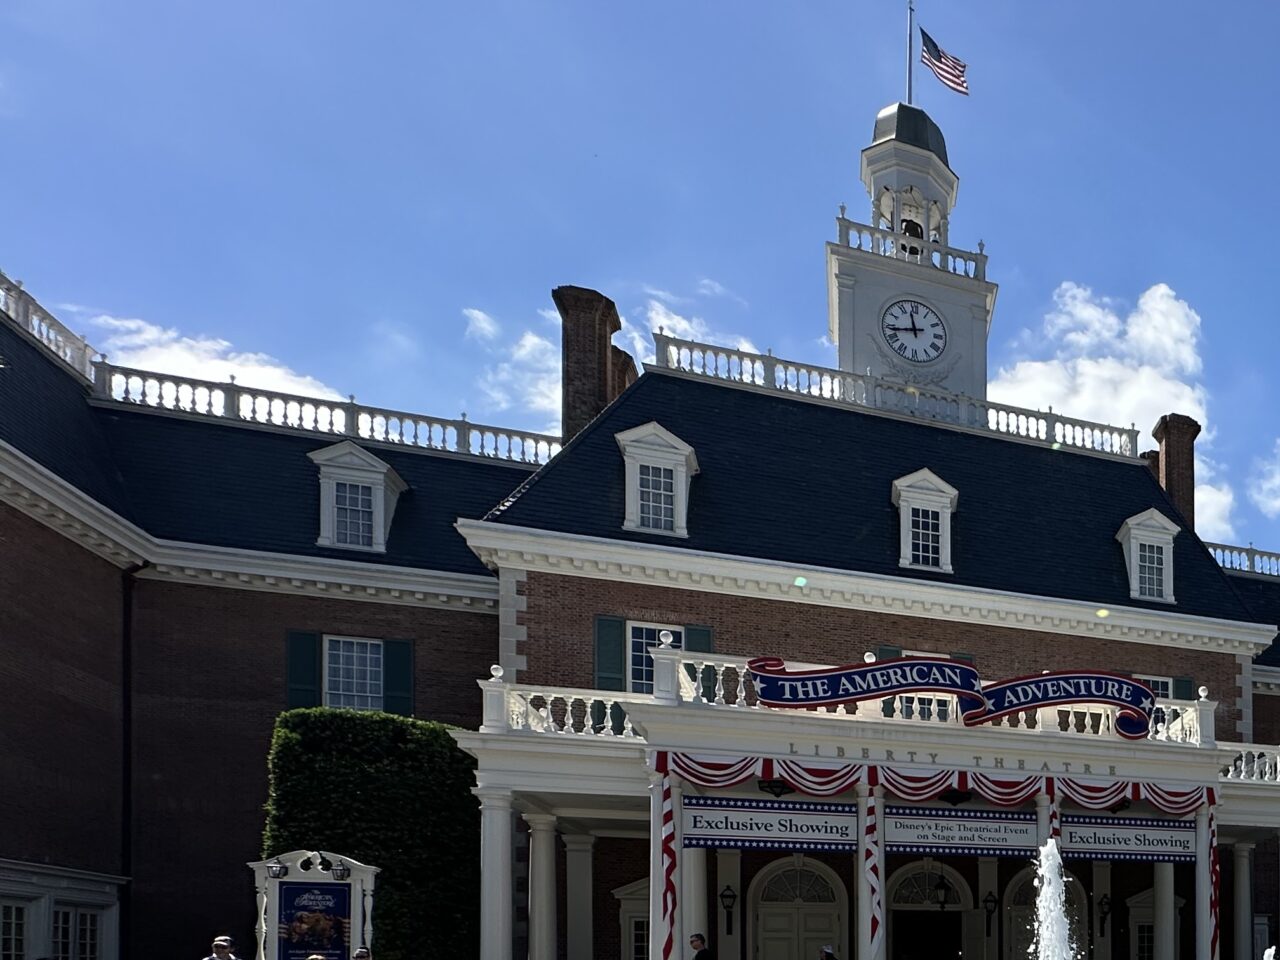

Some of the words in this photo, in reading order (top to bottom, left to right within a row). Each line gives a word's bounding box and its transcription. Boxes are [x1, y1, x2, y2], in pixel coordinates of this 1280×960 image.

[778, 679, 832, 699] THE
[838, 665, 962, 695] AMERICAN
[1003, 678, 1133, 707] ADVENTURE
[789, 742, 939, 764] LIBERTY
[973, 756, 1116, 776] THEATRE
[692, 815, 774, 832] Exclusive
[777, 818, 849, 838] Showing
[894, 820, 932, 832] Disney's
[934, 823, 954, 833] Epic
[956, 823, 1001, 834] Theatrical
[1003, 825, 1029, 835] Event
[931, 832, 956, 843] Stage
[958, 833, 975, 842] and
[978, 834, 1008, 843] Screen
[1068, 831, 1131, 846] Exclusive
[1134, 833, 1190, 850] Showing
